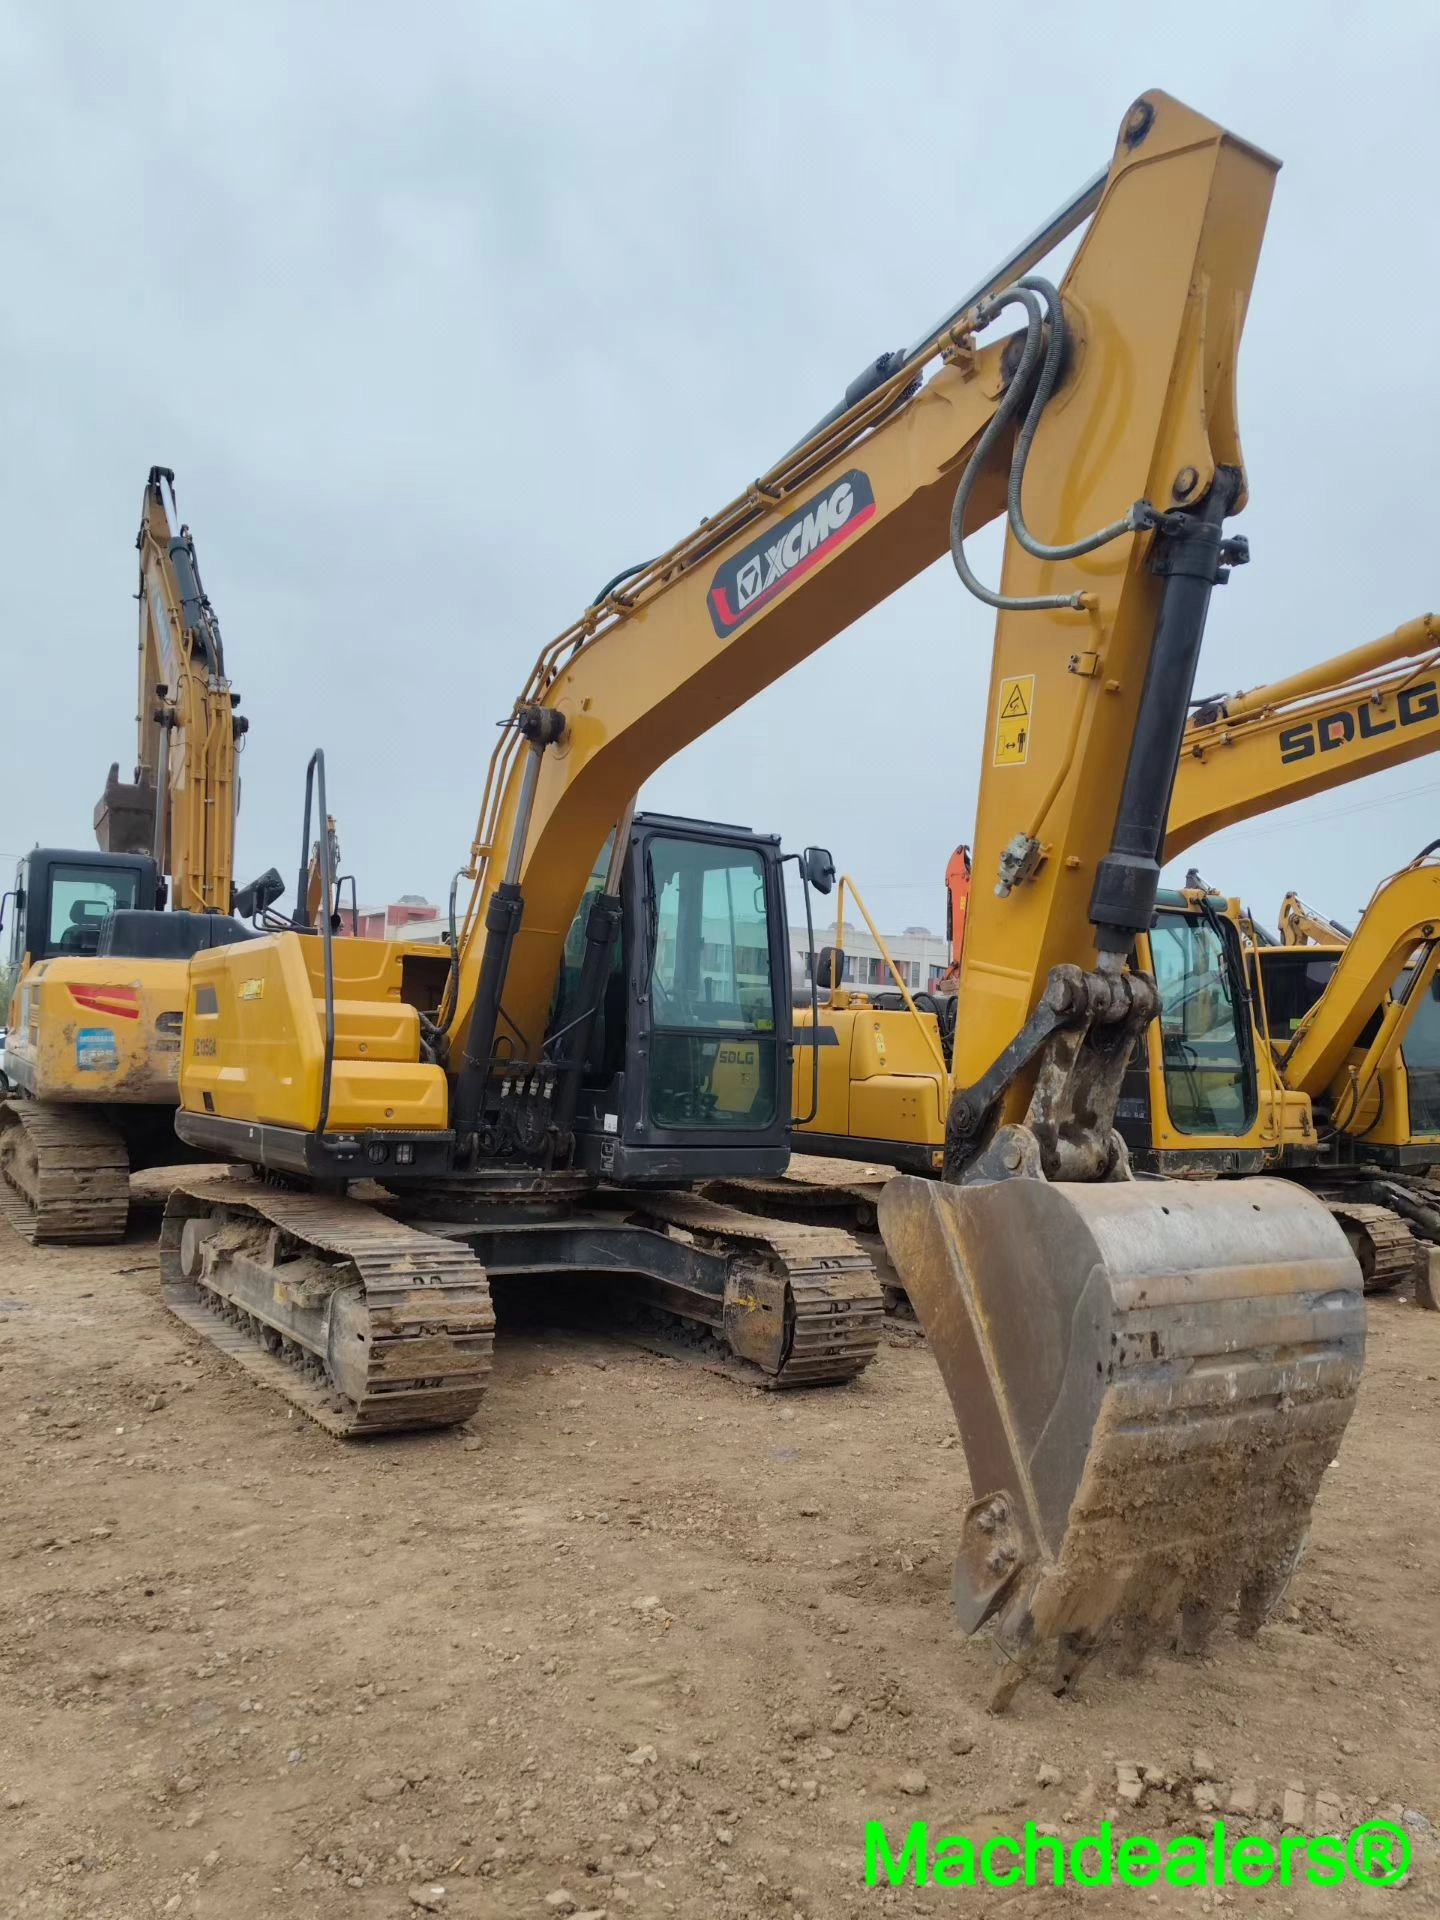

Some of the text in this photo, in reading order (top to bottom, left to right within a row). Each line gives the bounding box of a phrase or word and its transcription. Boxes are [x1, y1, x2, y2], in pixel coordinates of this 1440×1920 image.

[762, 482, 854, 591] XCMG
[1279, 680, 1440, 765] SDLG
[719, 1050, 754, 1065] SDLG
